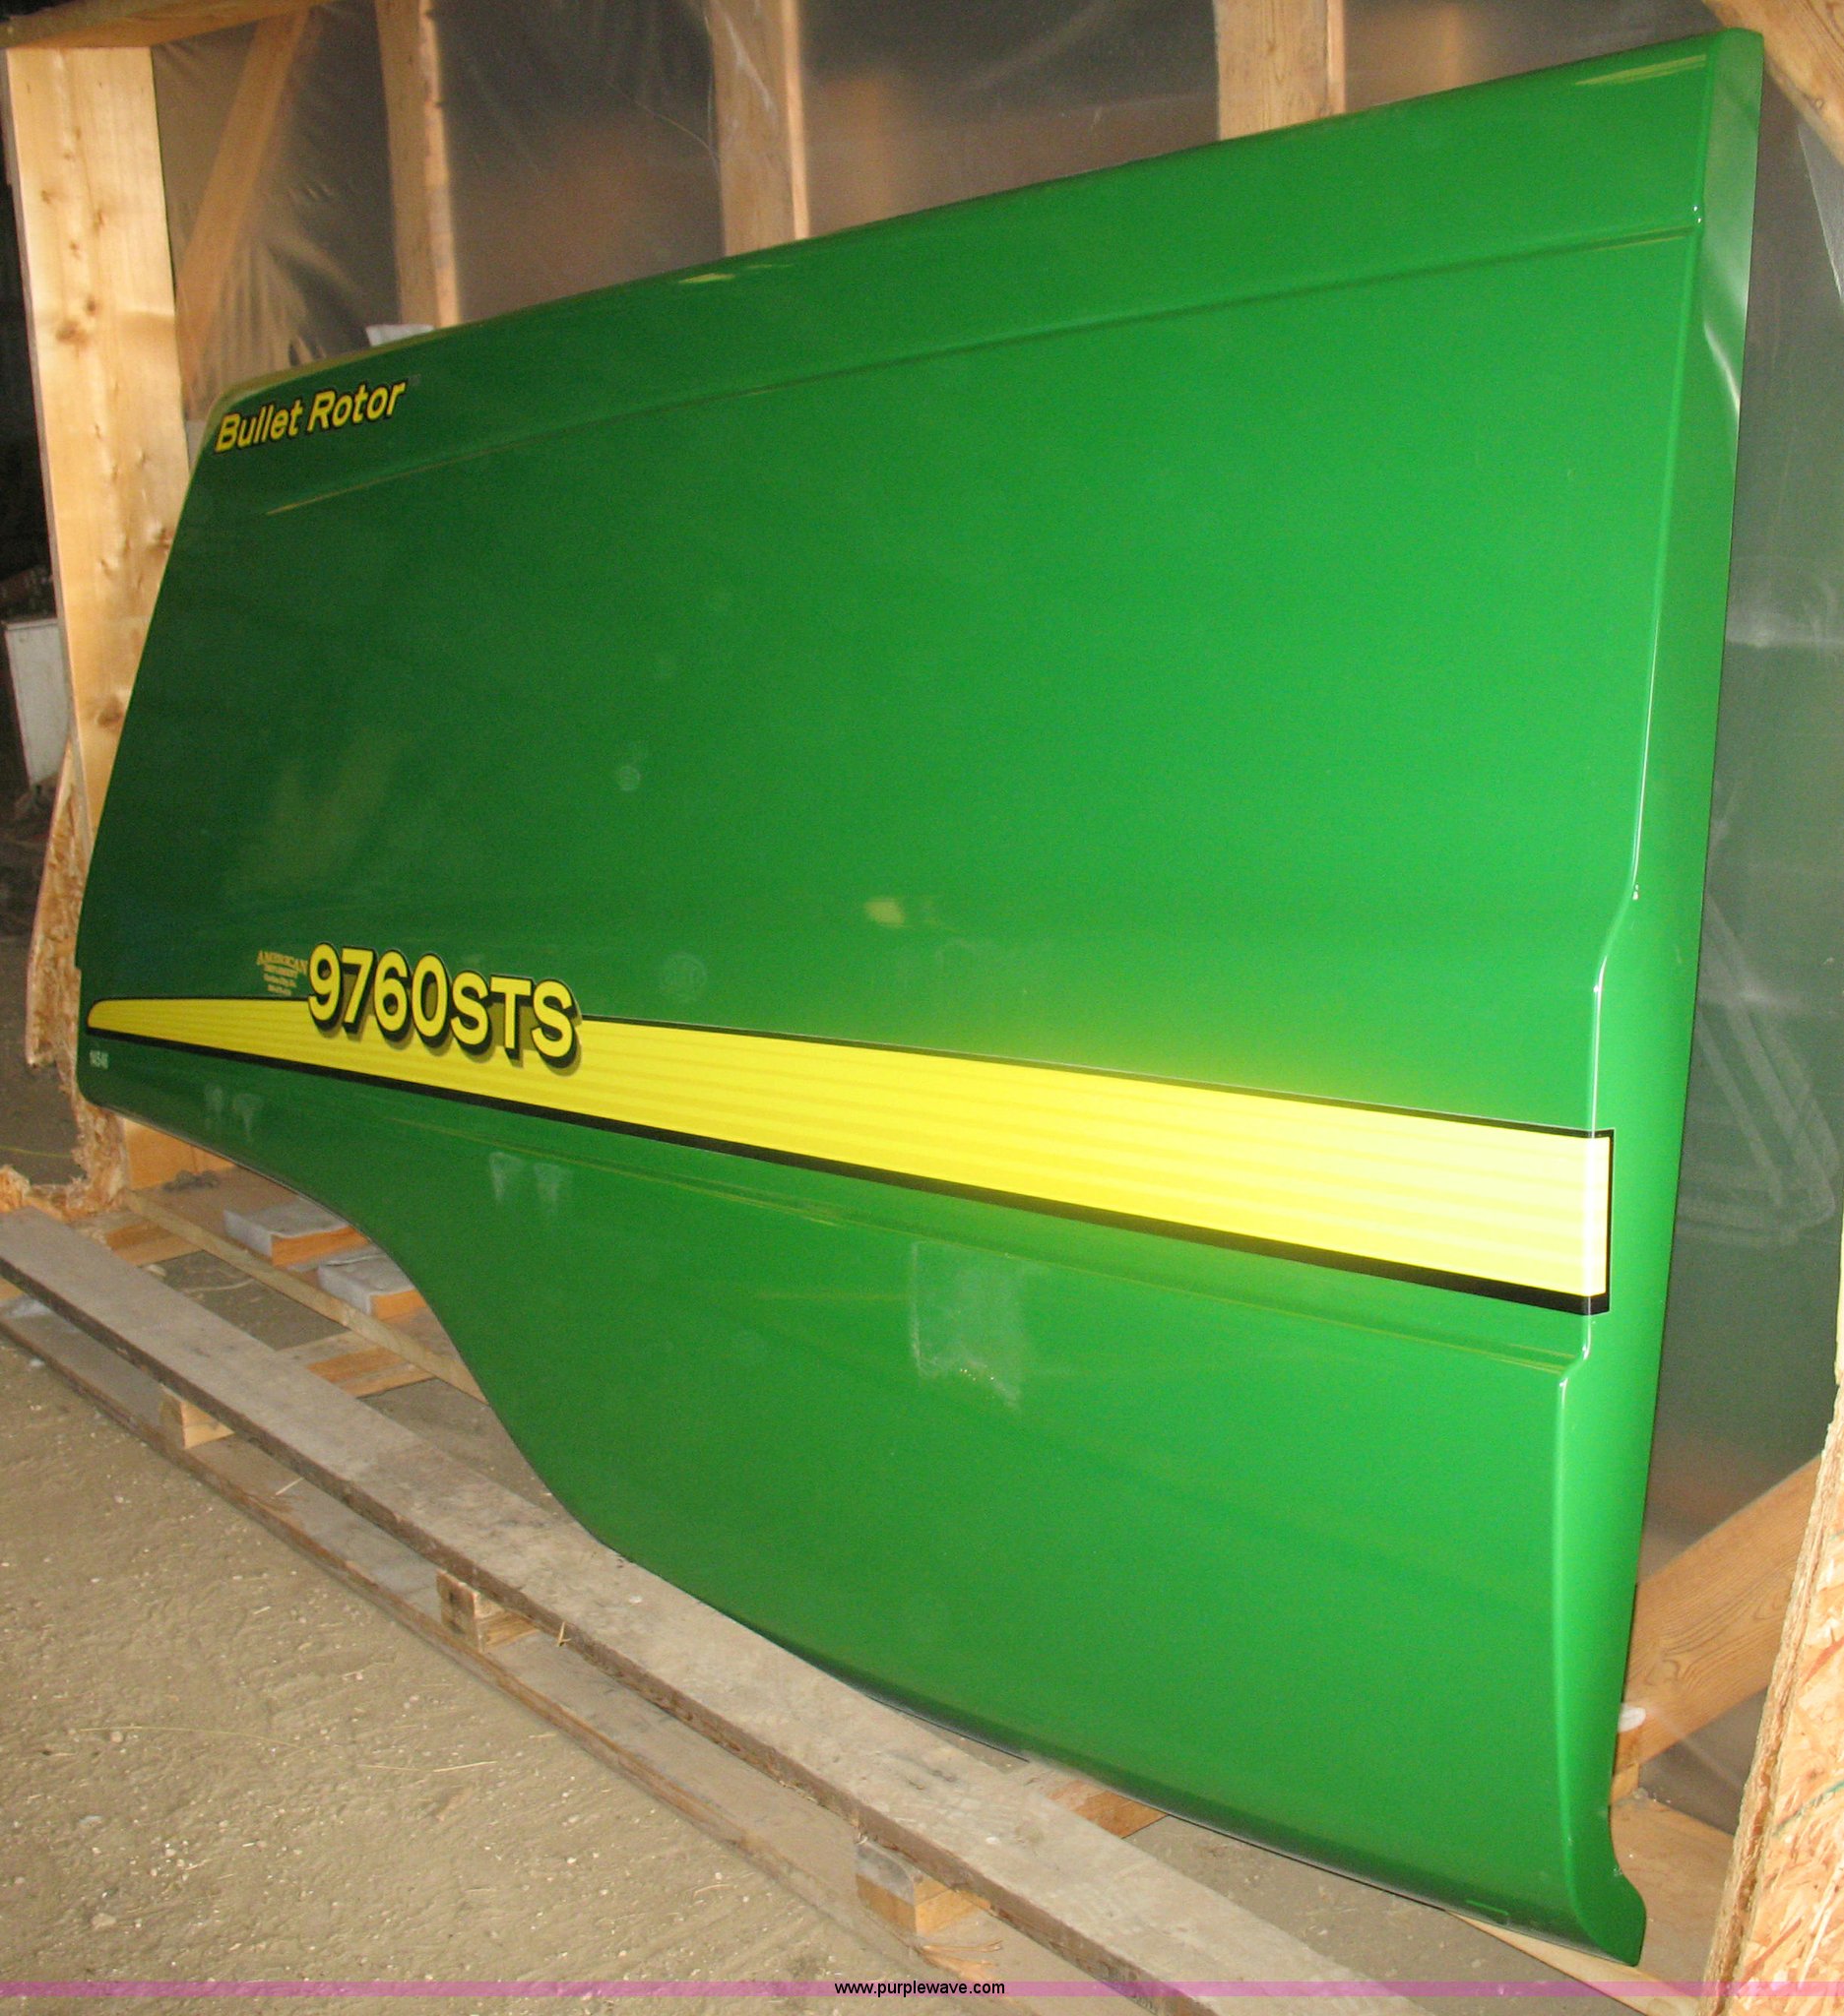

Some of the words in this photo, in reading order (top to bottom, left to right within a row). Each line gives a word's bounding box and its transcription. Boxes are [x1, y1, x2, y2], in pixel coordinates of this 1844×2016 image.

[215, 399, 304, 453] Bullet
[306, 381, 408, 433] Rotor
[306, 942, 580, 1070] 9760STS
